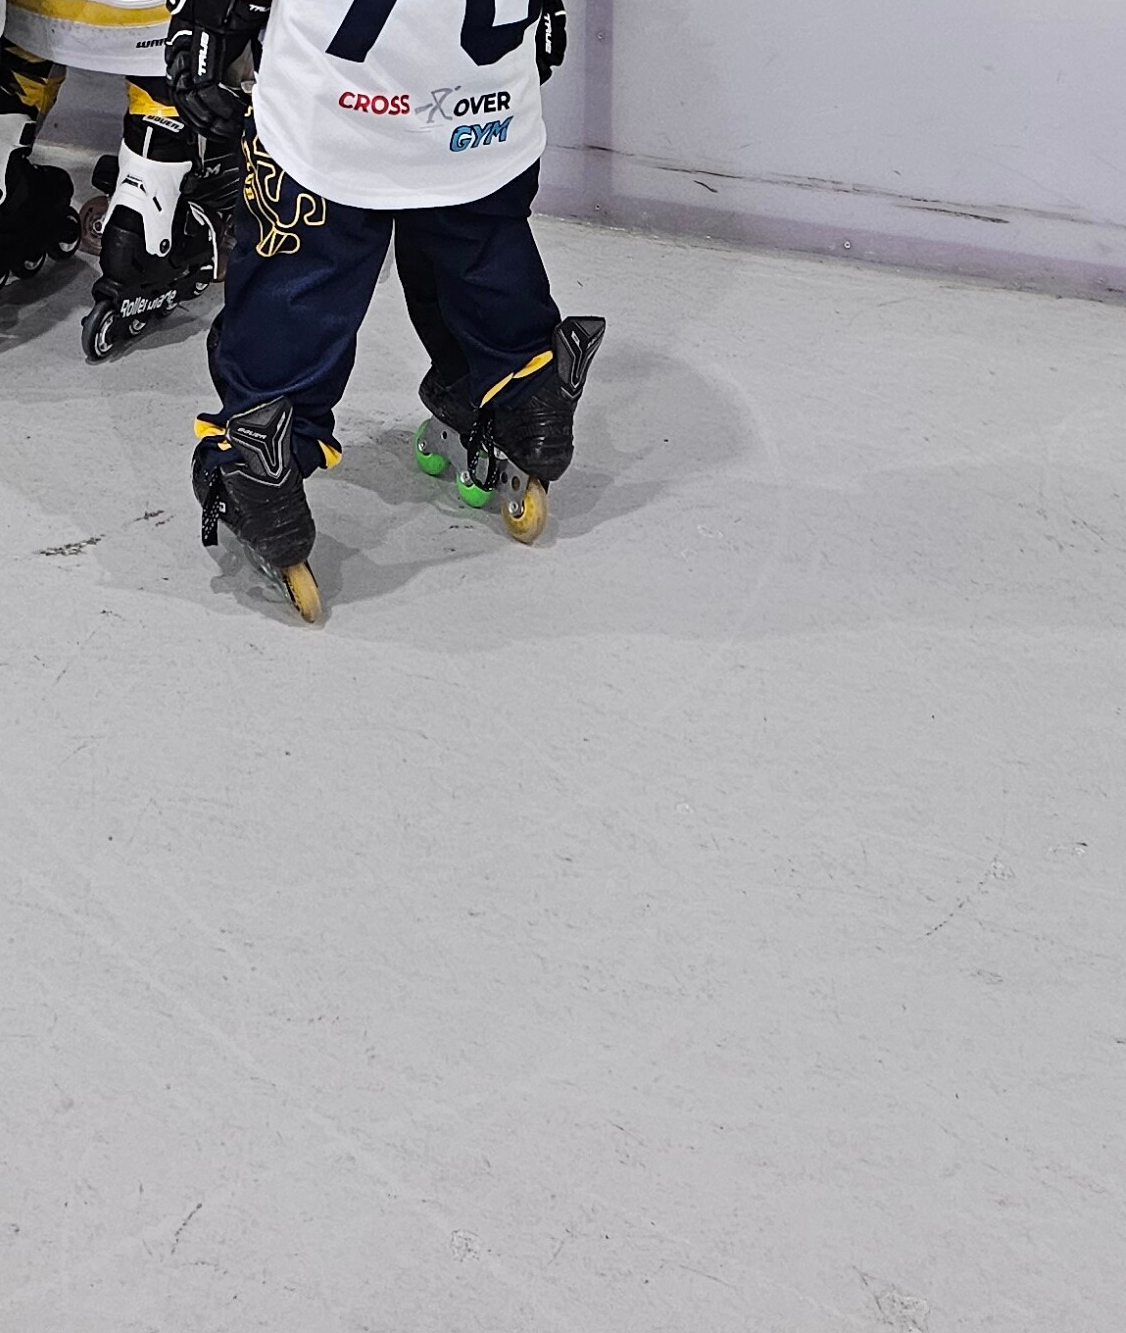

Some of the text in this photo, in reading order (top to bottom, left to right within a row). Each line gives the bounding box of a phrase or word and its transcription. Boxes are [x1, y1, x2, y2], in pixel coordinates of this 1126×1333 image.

[338, 90, 512, 118] CROSS OVER
[449, 116, 514, 153] GYM
